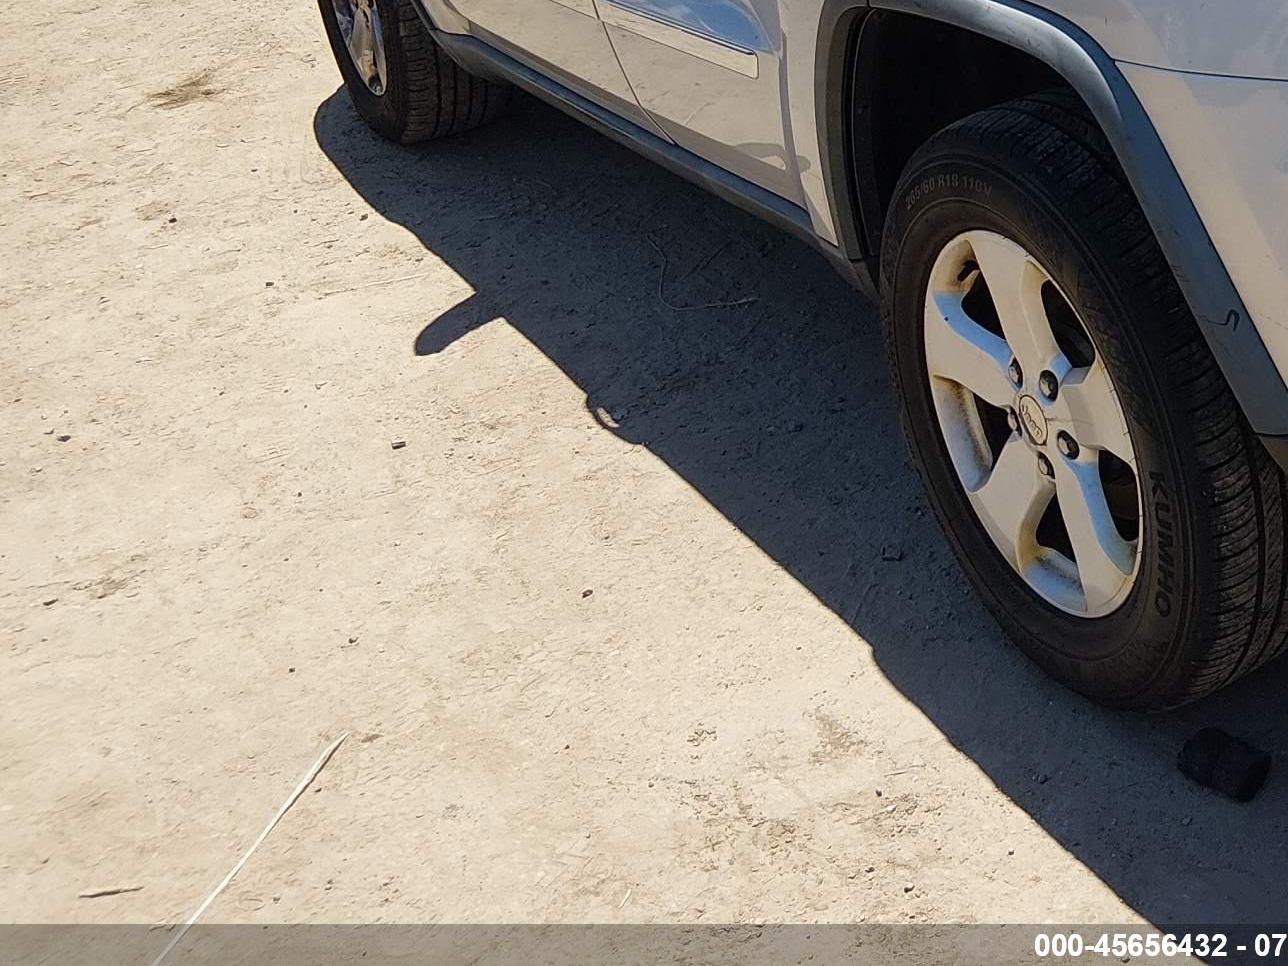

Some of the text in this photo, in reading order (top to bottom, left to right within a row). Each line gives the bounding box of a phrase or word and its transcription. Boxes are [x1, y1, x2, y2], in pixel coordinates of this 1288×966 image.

[905, 177, 935, 211] 265/60
[938, 174, 959, 187] R18
[1149, 470, 1175, 619] KUMHO
